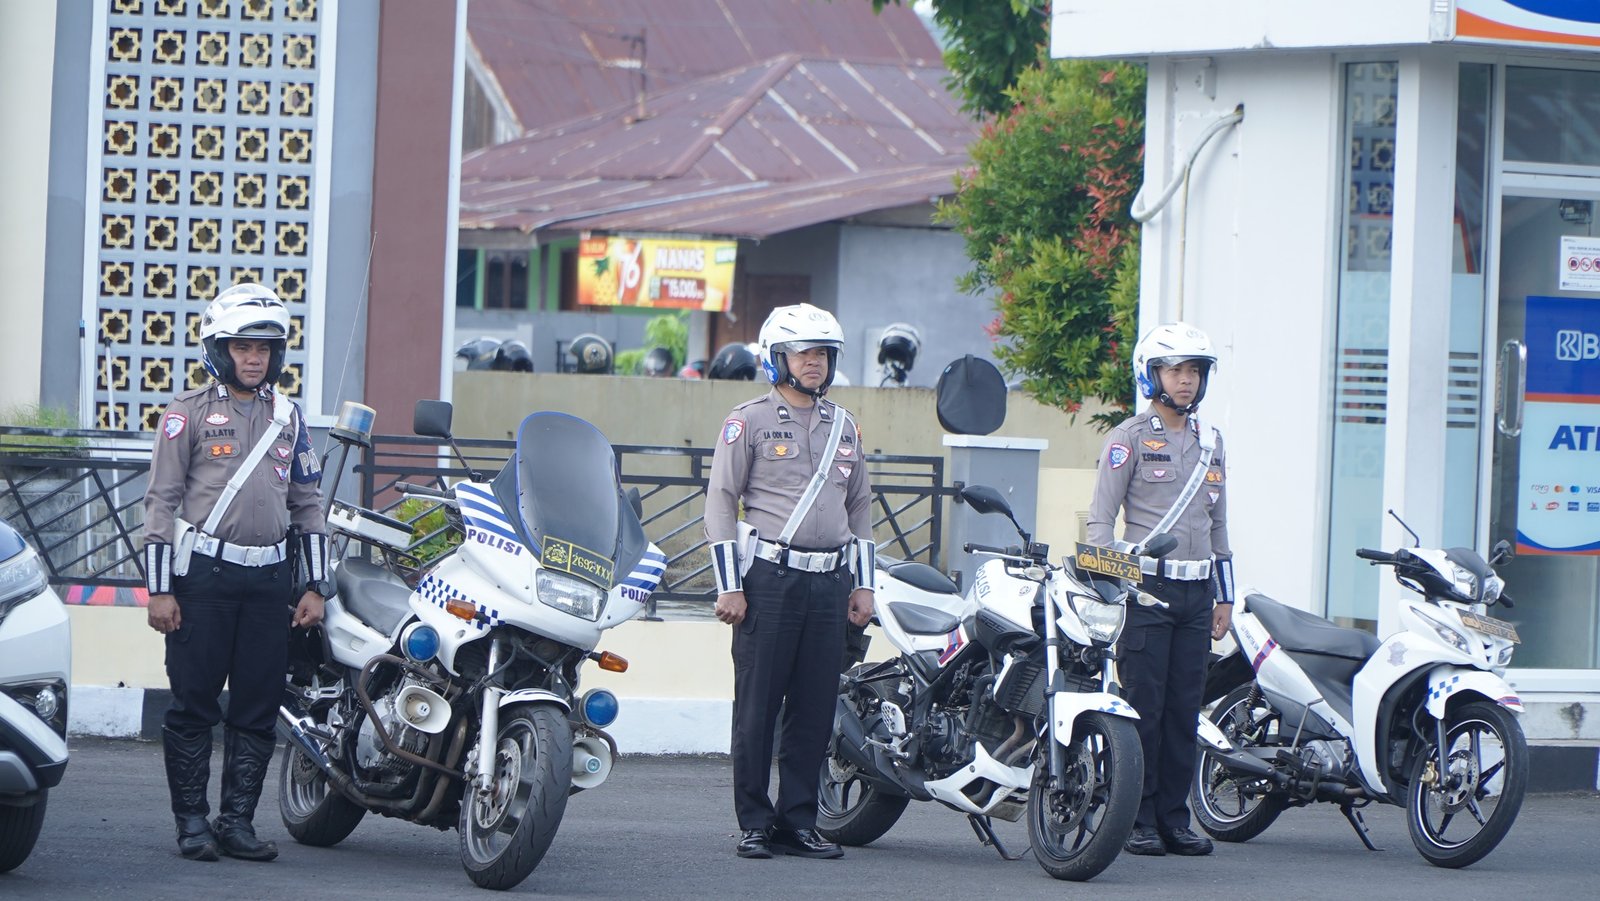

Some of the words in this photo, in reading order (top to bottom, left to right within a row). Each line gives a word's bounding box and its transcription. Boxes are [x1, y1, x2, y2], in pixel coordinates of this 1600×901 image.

[656, 247, 704, 271] NANAS
[205, 429, 235, 439] A.LATIF
[1548, 425, 1600, 451] AT
[467, 528, 523, 556] POLISI
[1100, 559, 1140, 580] 1624-29
